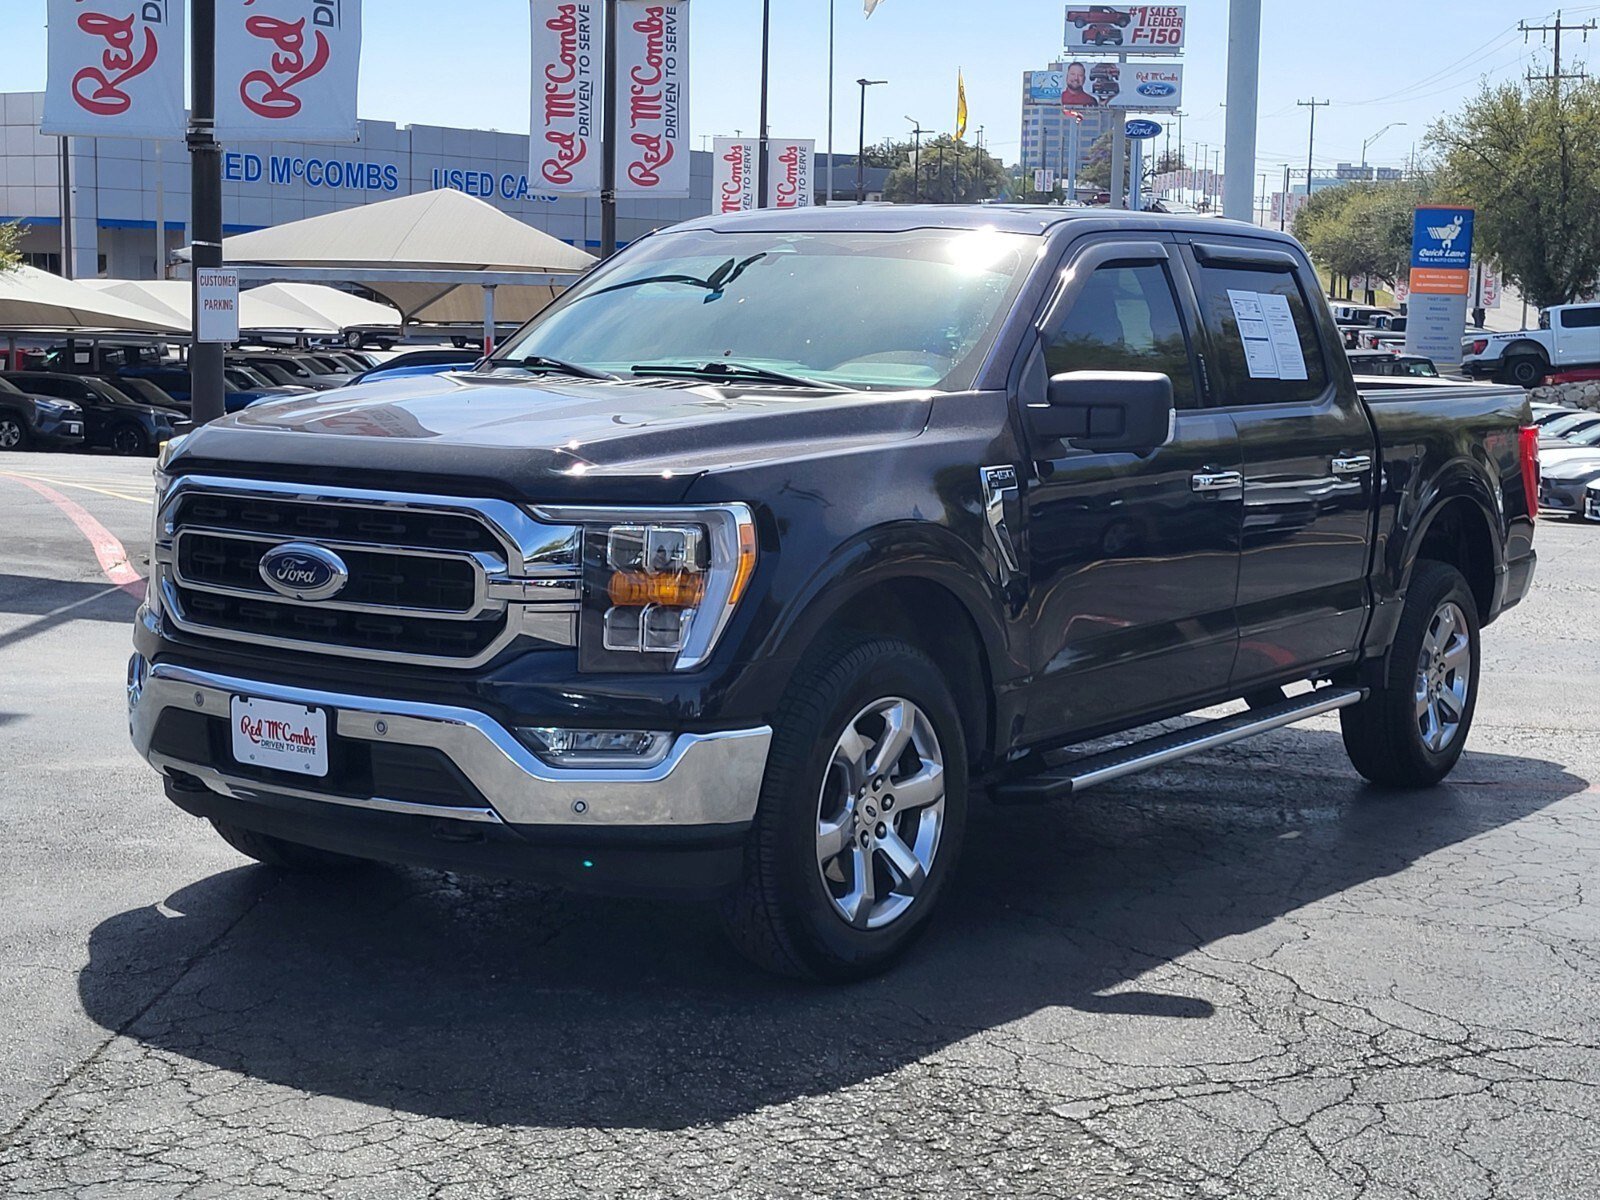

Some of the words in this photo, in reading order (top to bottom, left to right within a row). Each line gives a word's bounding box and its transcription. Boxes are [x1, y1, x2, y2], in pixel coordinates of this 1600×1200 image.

[1129, 6, 1147, 27] #1
[1147, 17, 1183, 27] LEADER
[1149, 7, 1178, 17] SALES
[578, 4, 590, 51] SERVE
[665, 7, 677, 53] SERVE
[1131, 28, 1181, 45] F-150
[72, 12, 158, 116] Red
[240, 15, 330, 119] Red
[545, 4, 577, 127] McCombs
[579, 55, 590, 76] TO
[630, 6, 664, 129] McCombs
[665, 57, 677, 78] TO
[579, 81, 592, 137] DRIVEN
[665, 82, 680, 139] DRIVEN
[1125, 123, 1154, 135] Ford
[222, 153, 262, 182] ED
[542, 131, 587, 184] Red
[628, 133, 674, 187] Red
[743, 145, 752, 174] SERVE
[798, 146, 807, 176] SERVE
[433, 169, 494, 197] USED
[501, 174, 558, 201] CA
[743, 176, 751, 190] TO
[798, 178, 807, 192] TO
[1418, 248, 1445, 257] Quick
[1445, 249, 1466, 258] Lane
[200, 275, 236, 287] CUSTOMER
[204, 299, 234, 310] PARKING
[277, 557, 317, 583] Ford
[241, 715, 262, 744] Red
[264, 719, 316, 746] McCombs
[260, 739, 285, 752] DRIVEN
[286, 744, 295, 752] TO
[296, 745, 316, 755] SERVE
